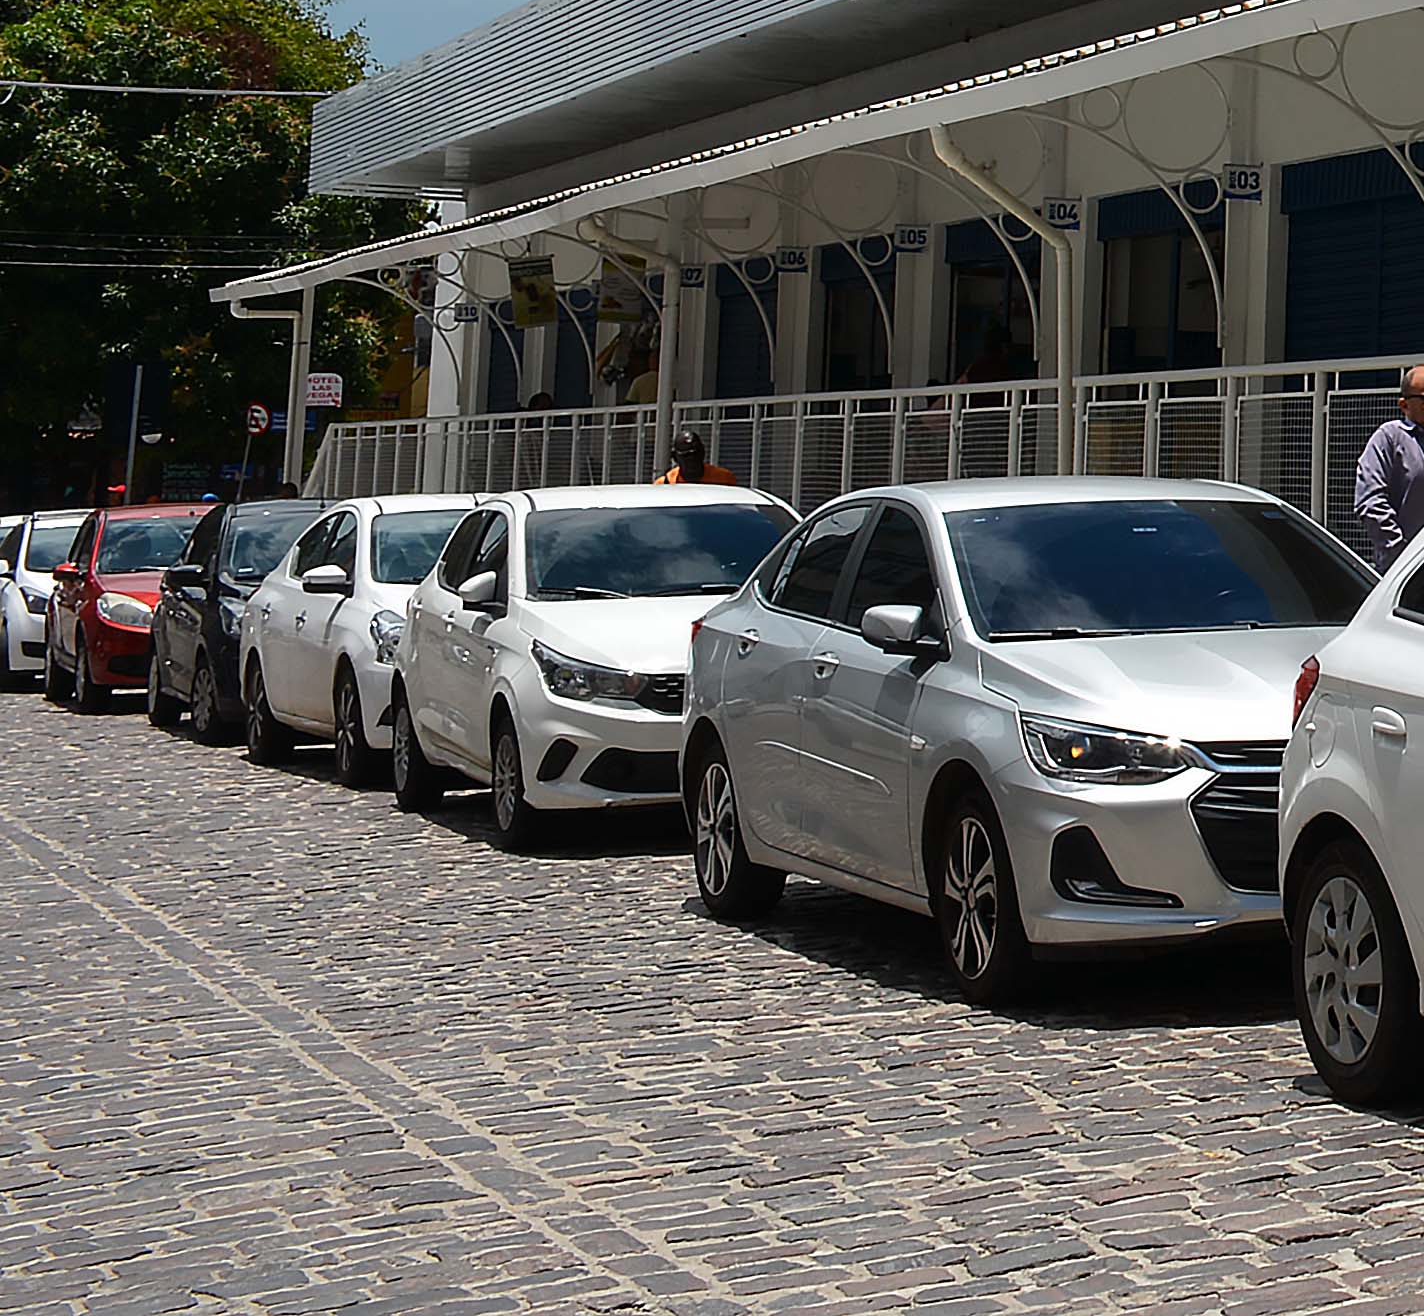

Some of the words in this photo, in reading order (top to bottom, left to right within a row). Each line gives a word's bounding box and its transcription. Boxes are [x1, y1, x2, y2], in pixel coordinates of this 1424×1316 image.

[1237, 171, 1260, 190] 03
[1057, 203, 1078, 221] 04
[906, 229, 928, 245] 05
[787, 251, 806, 265] 06
[685, 267, 702, 281] 07
[464, 306, 477, 316] 10
